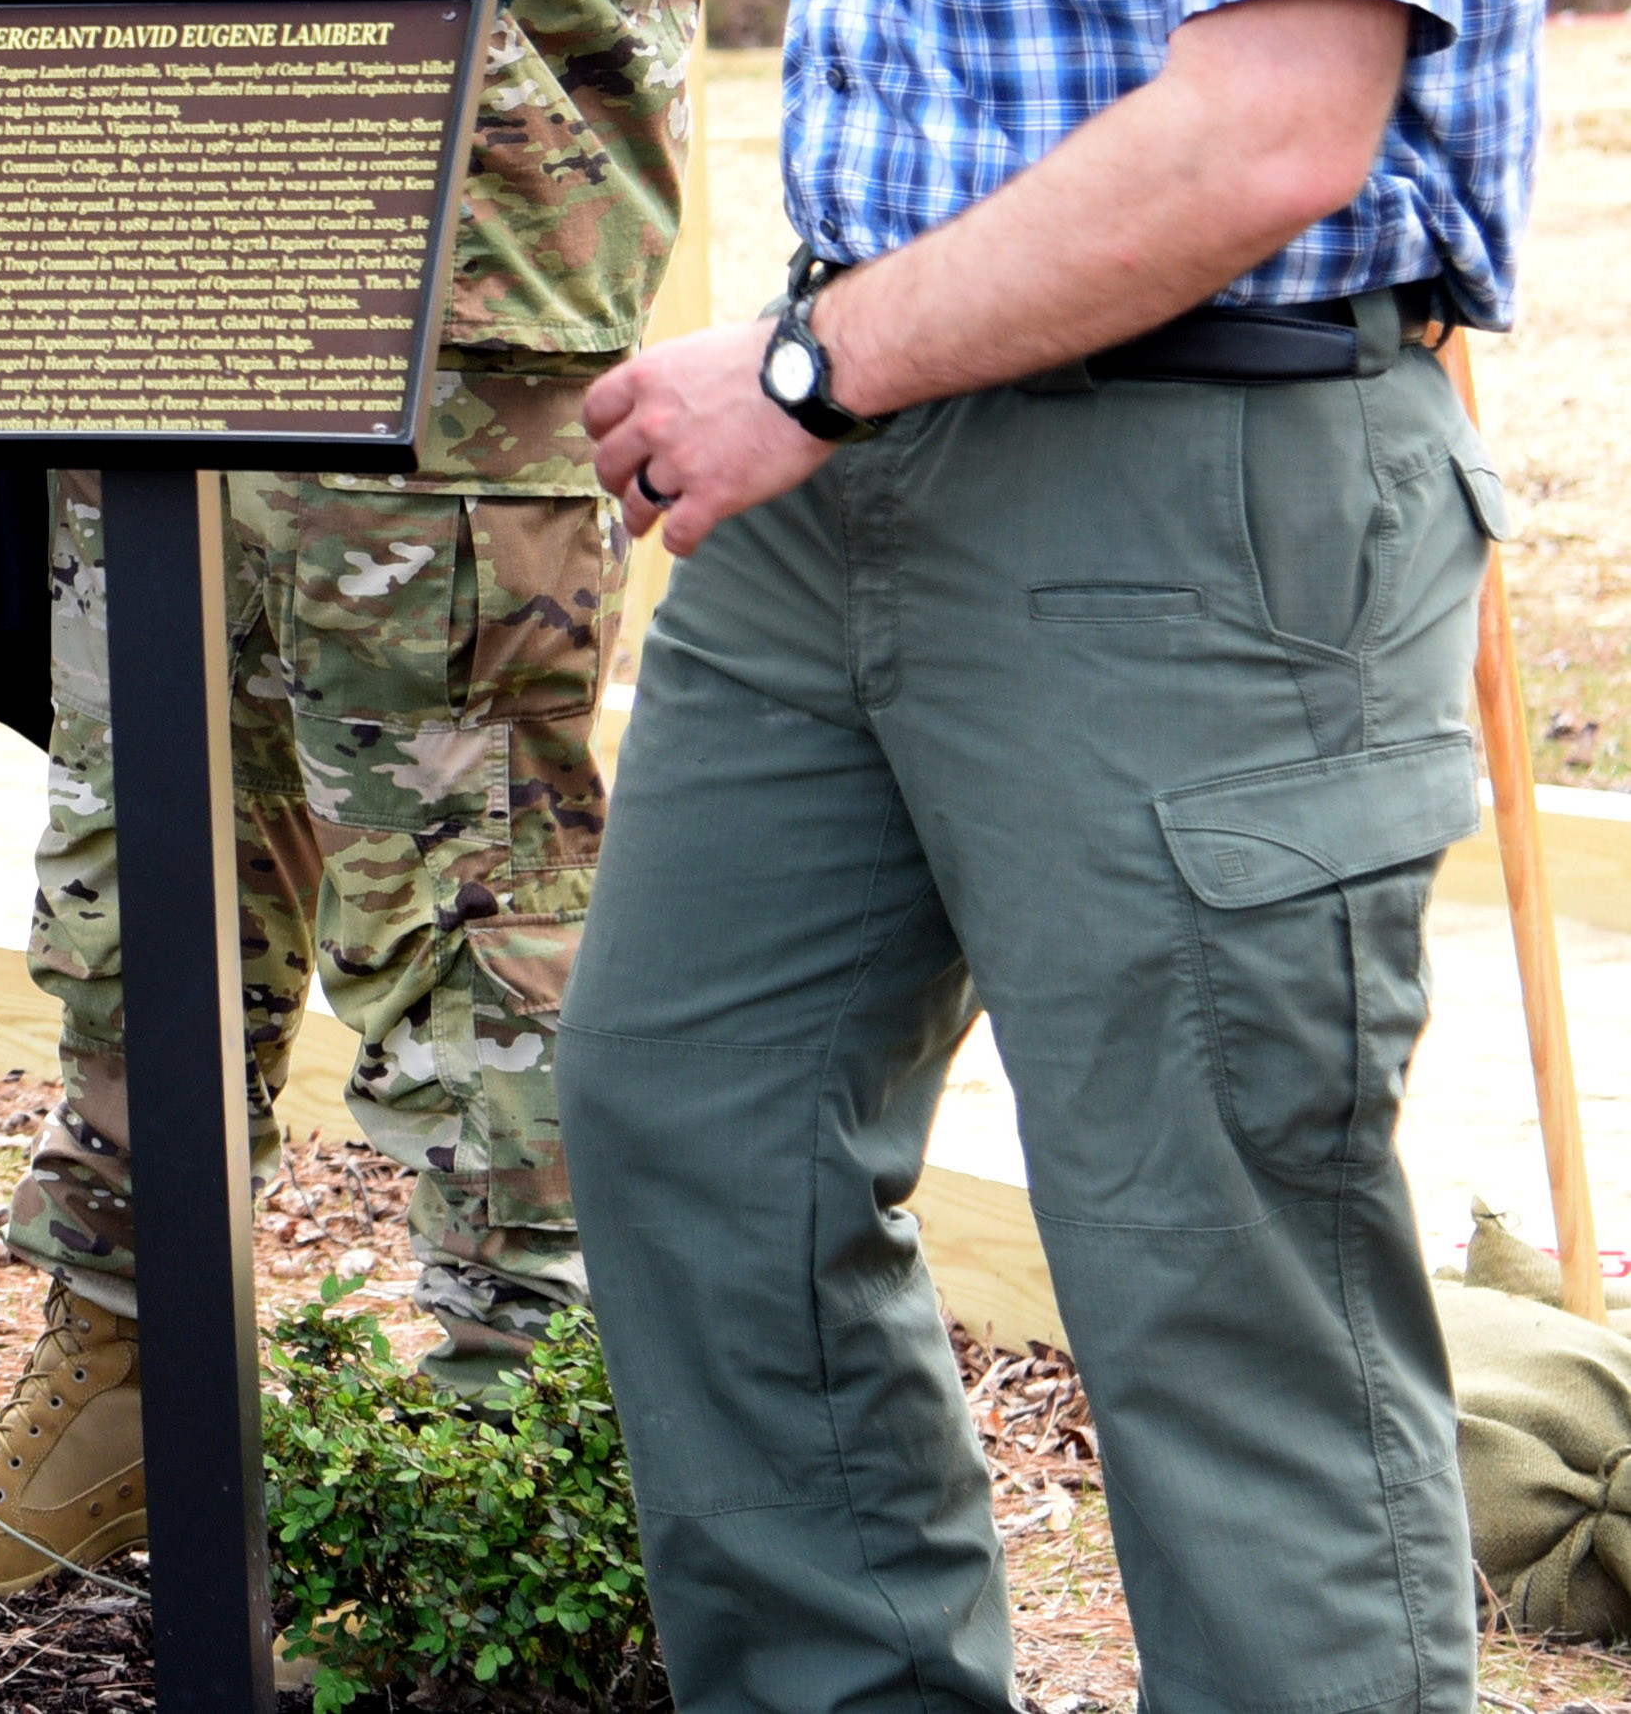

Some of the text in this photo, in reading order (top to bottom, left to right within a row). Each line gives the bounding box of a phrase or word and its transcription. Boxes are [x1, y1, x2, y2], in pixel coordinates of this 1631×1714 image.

[103, 25, 178, 48] DAVID
[180, 24, 278, 47] EUGENE
[281, 23, 394, 46] LAMBERT
[39, 64, 86, 78] Lambert
[88, 64, 101, 77] of
[213, 63, 263, 80] formerly
[265, 62, 278, 76] of
[279, 62, 313, 75] Cedar
[349, 61, 395, 79] Virginia
[397, 65, 419, 74] was
[421, 61, 455, 74] killed
[24, 102, 41, 115] his
[43, 102, 84, 120] country
[86, 102, 98, 115] in
[1, 159, 69, 177] Community
[142, 162, 156, 171] as
[158, 158, 174, 171] he
[176, 162, 198, 171] was
[200, 158, 241, 171] known
[243, 158, 256, 171] to
[296, 157, 342, 171] worked
[343, 161, 357, 170] as
[369, 157, 436, 170] corrections
[32, 217, 45, 230] in
[47, 217, 67, 230] the
[69, 217, 101, 235] Army
[103, 217, 117, 230] in
[150, 217, 174, 230] and
[175, 217, 188, 230] in
[190, 217, 211, 230] the
[213, 216, 261, 234] Virginia
[263, 216, 315, 229] National
[317, 216, 356, 229] Guard
[357, 216, 371, 229] in
[409, 216, 429, 229] He
[17, 300, 65, 314] weapons
[67, 296, 115, 314] operator
[117, 296, 139, 309] and
[141, 296, 175, 309] driver
[176, 296, 194, 309] for
[196, 296, 226, 309] Mine
[228, 296, 269, 309] Protect
[271, 296, 307, 313] Utility
[34, 336, 112, 354] Expeditionary
[155, 336, 178, 349] and
[189, 336, 234, 349] Combat
[235, 336, 273, 349] Action
